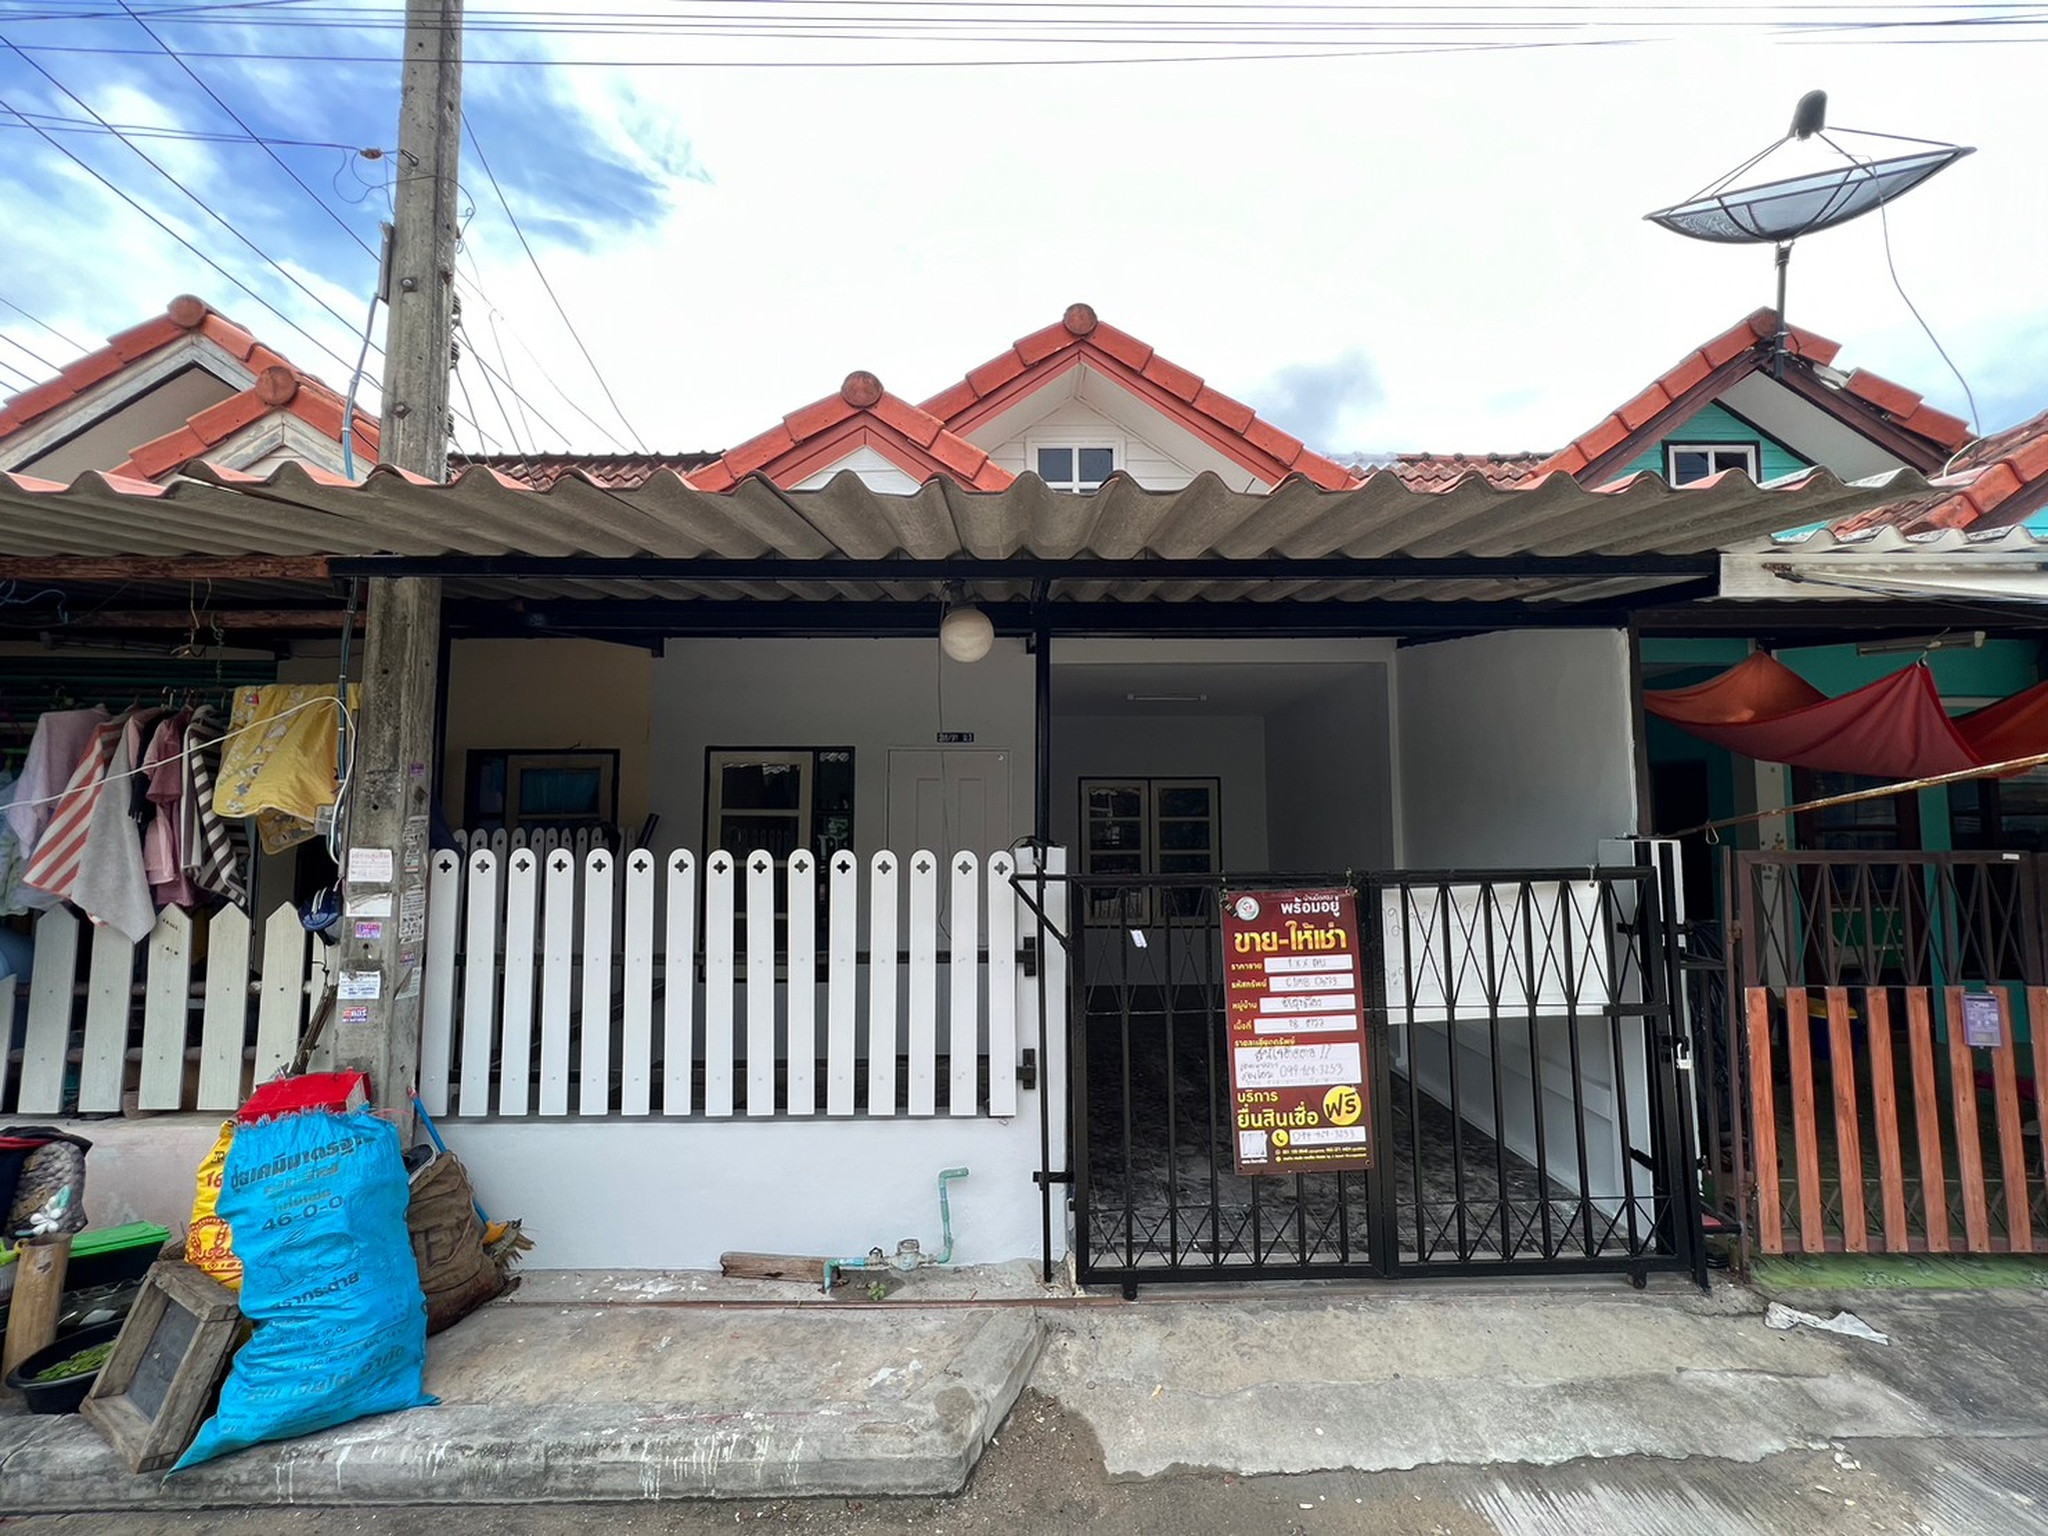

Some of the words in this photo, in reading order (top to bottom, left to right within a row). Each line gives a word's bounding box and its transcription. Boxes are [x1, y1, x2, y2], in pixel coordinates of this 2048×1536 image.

[1281, 896, 1340, 917] พร้อมอยู่
[1234, 920, 1347, 953] ขาย-ให้เช่า
[1231, 962, 1263, 971] ราคาขาย
[1232, 1000, 1258, 1012] หมู่บ้าน
[1237, 1089, 1279, 1103] บริการ
[1326, 1092, 1357, 1119] ฟรี
[1237, 1101, 1319, 1129] ยื่นสินเชื่อ
[261, 1195, 344, 1231] 46-0-0
